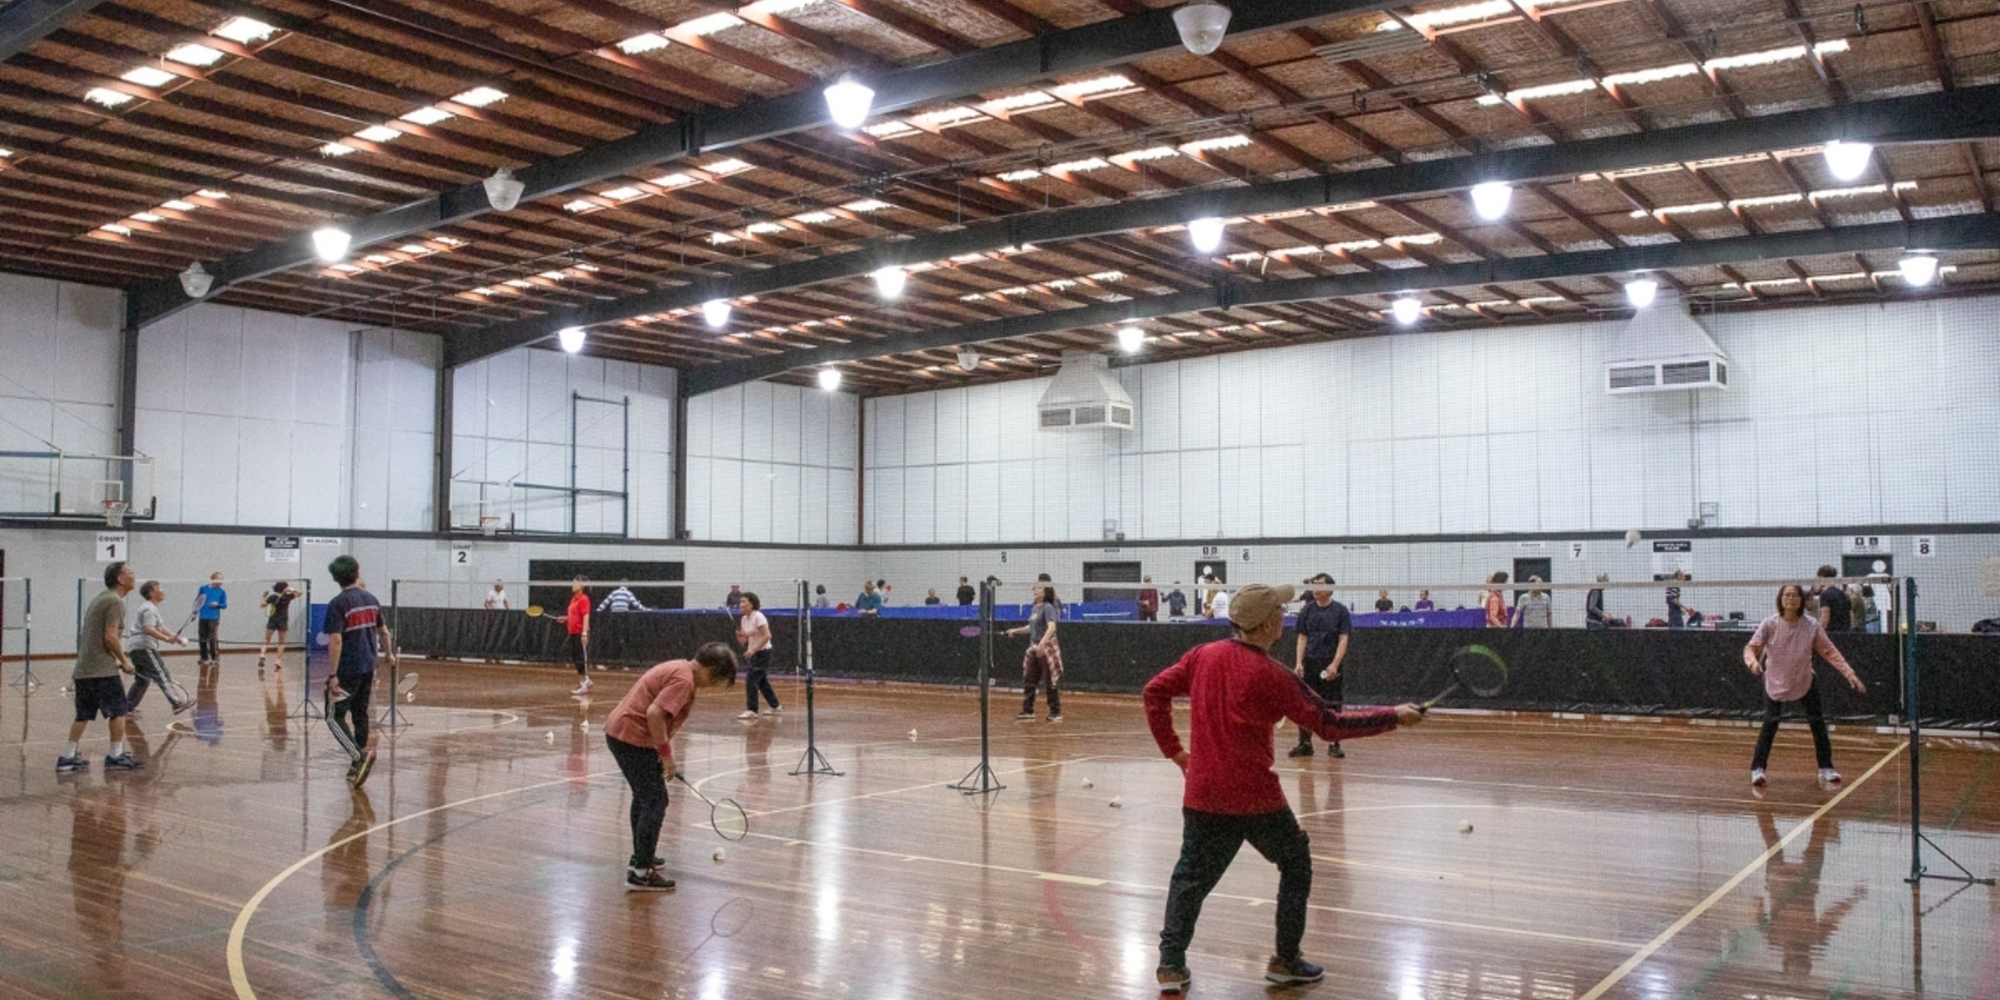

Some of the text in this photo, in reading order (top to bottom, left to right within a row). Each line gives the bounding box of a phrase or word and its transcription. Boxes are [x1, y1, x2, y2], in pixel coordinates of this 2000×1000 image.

[106, 543, 115, 558] 1
[1573, 548, 1582, 558] 7
[1919, 543, 1930, 555] 8
[458, 551, 467, 563] 2
[1242, 552, 1251, 561] 6
